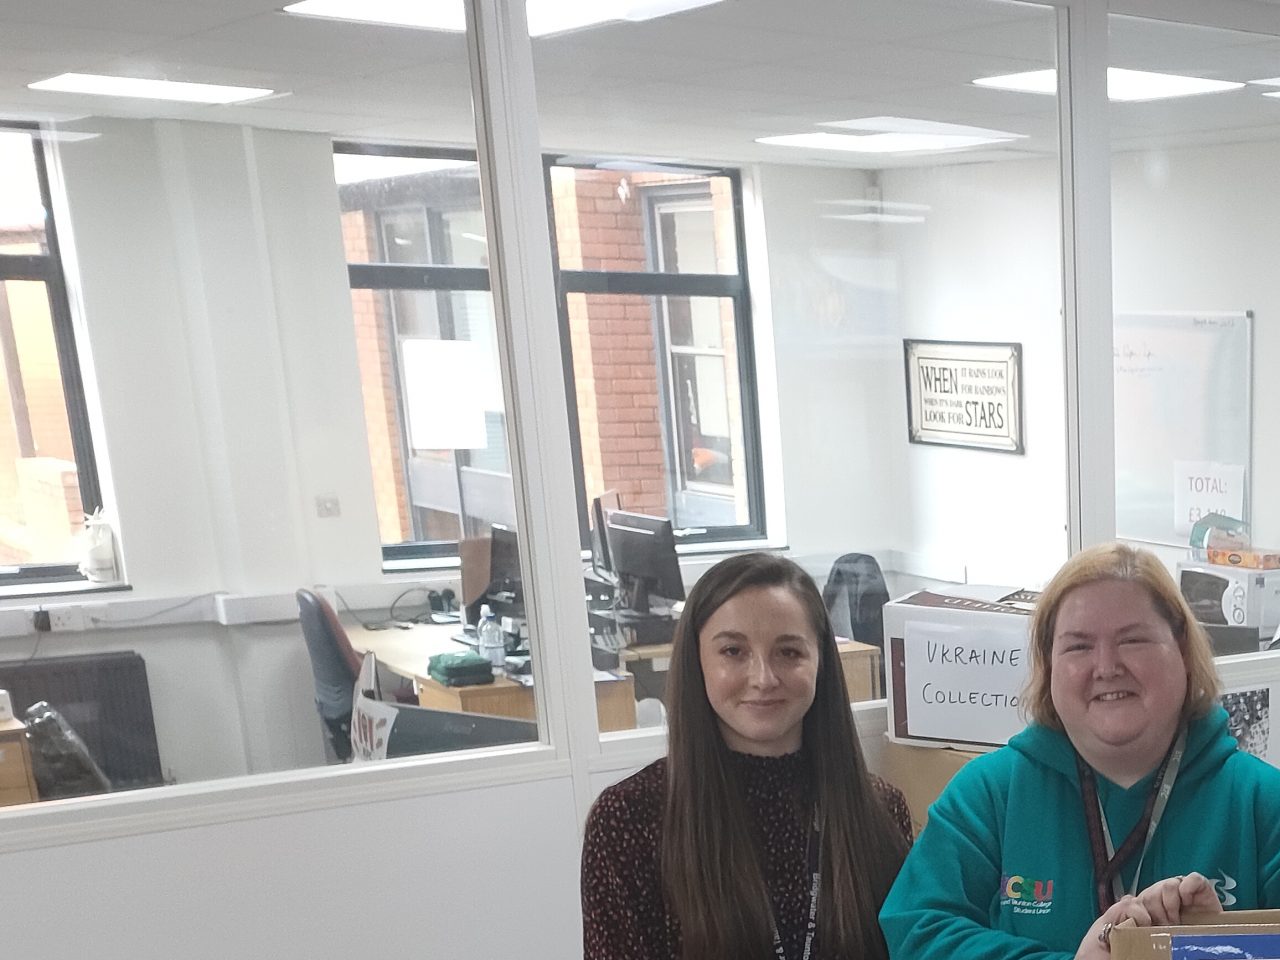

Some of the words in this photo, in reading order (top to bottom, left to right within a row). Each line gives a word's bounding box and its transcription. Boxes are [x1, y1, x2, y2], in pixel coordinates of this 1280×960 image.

[921, 366, 958, 394] WHEN
[969, 368, 986, 378] RAINS
[988, 369, 1004, 379] LOOK
[961, 384, 973, 394] FOR
[925, 410, 946, 423] LOOK
[948, 412, 964, 424] FOR
[965, 401, 1004, 429] STARS
[1188, 476, 1228, 494] TOTAL:
[927, 640, 1022, 667] UKRAINE
[922, 682, 1018, 708] COLLECTIO
[809, 872, 821, 921] Bridgwater
[808, 921, 816, 929] &
